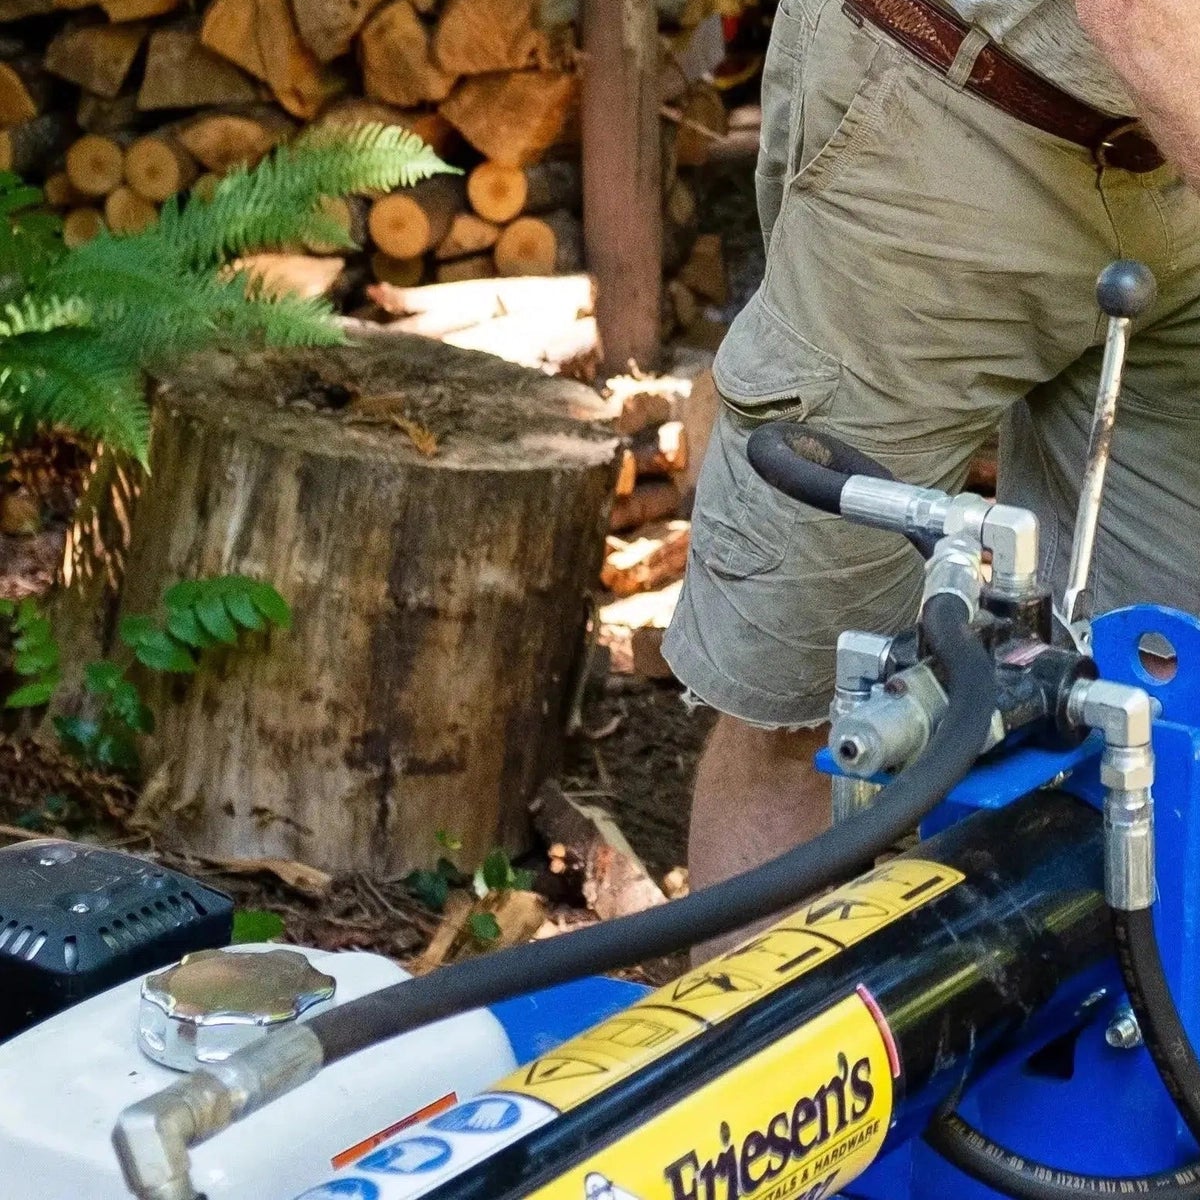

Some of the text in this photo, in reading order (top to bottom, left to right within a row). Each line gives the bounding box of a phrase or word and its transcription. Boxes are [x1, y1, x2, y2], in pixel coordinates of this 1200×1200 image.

[664, 1051, 875, 1200] Friesen's
[801, 1168, 809, 1183] &
[814, 1120, 881, 1175] HARDWARE
